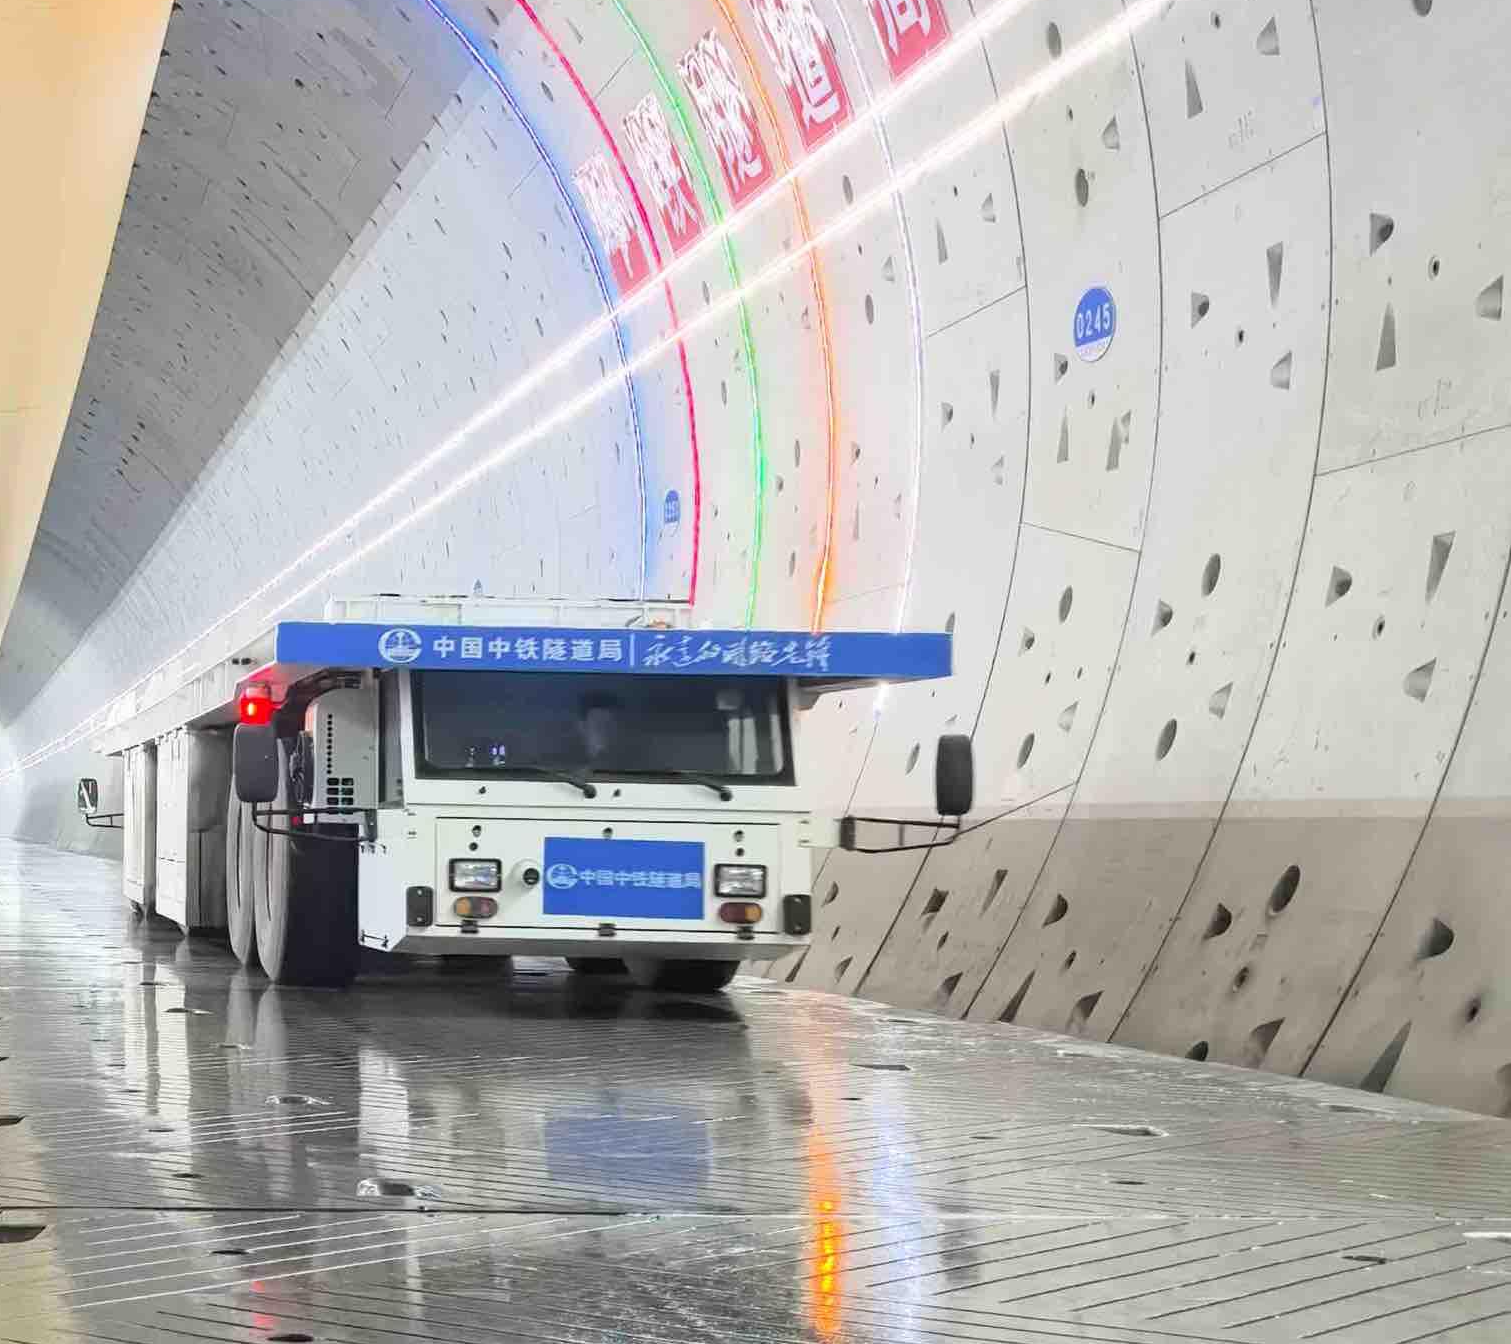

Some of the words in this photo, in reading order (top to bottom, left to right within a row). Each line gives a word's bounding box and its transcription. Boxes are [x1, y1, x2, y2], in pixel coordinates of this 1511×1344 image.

[1076, 303, 1111, 340] 0245
[432, 636, 622, 662] 中国中铁隧道局
[579, 868, 701, 889] 中国中铁隧道局
